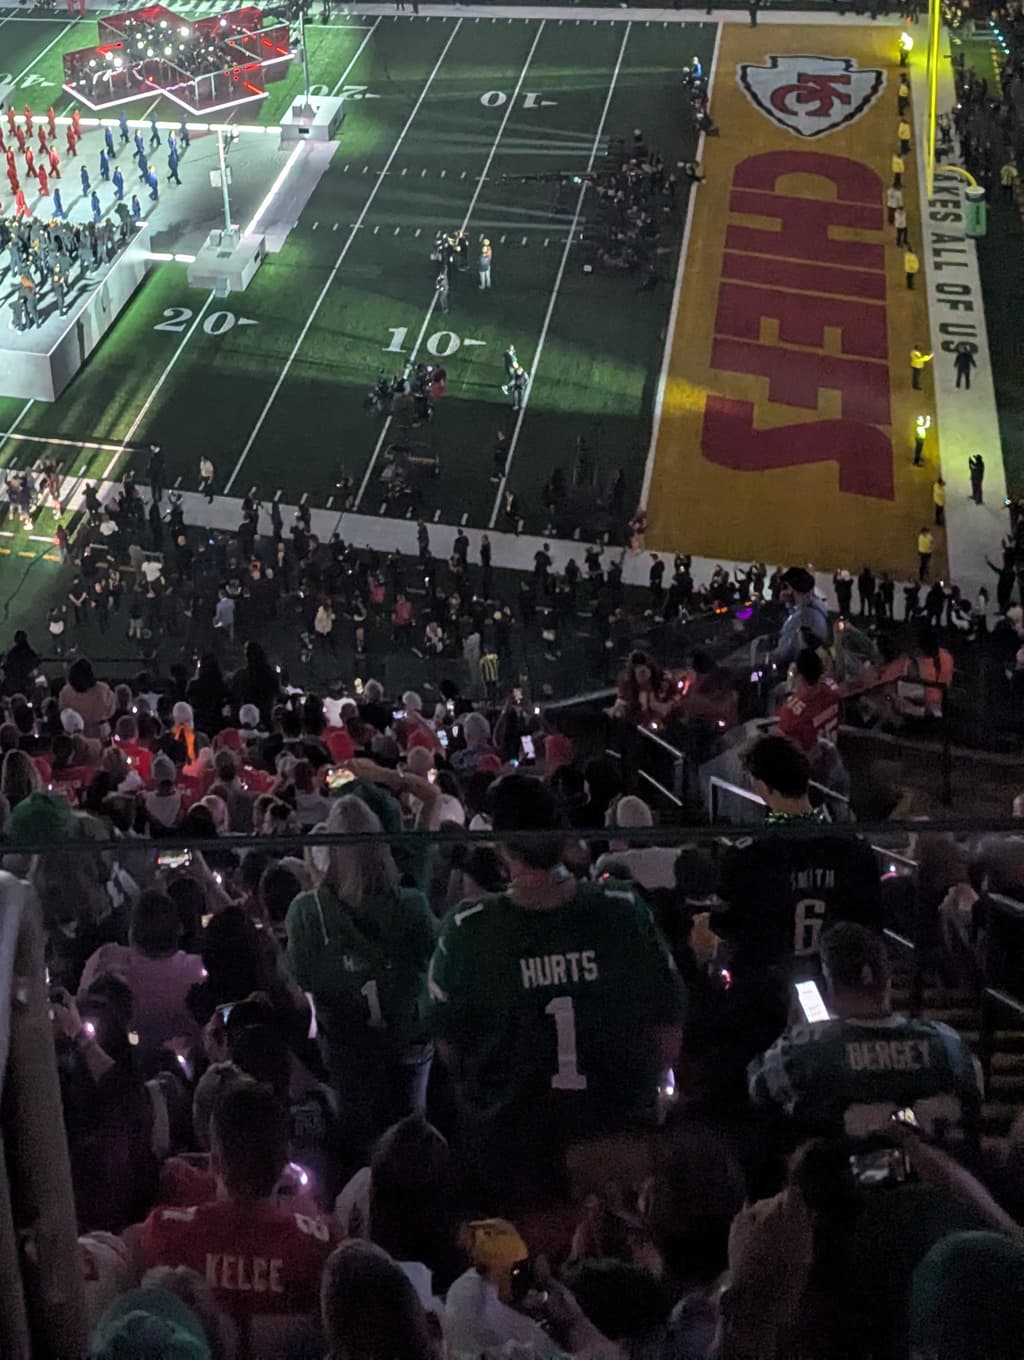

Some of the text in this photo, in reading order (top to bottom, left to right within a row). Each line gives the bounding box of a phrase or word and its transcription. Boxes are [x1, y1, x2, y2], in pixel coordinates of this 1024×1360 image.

[930, 232, 969, 271] ALL
[935, 282, 975, 313] OF
[153, 307, 236, 336] 20
[381, 326, 460, 357] 10
[701, 149, 895, 502] CHIEFS
[793, 898, 826, 957] 6
[519, 949, 599, 990] HURTS
[544, 995, 588, 1090] 1
[205, 1252, 284, 1294] KELCE
